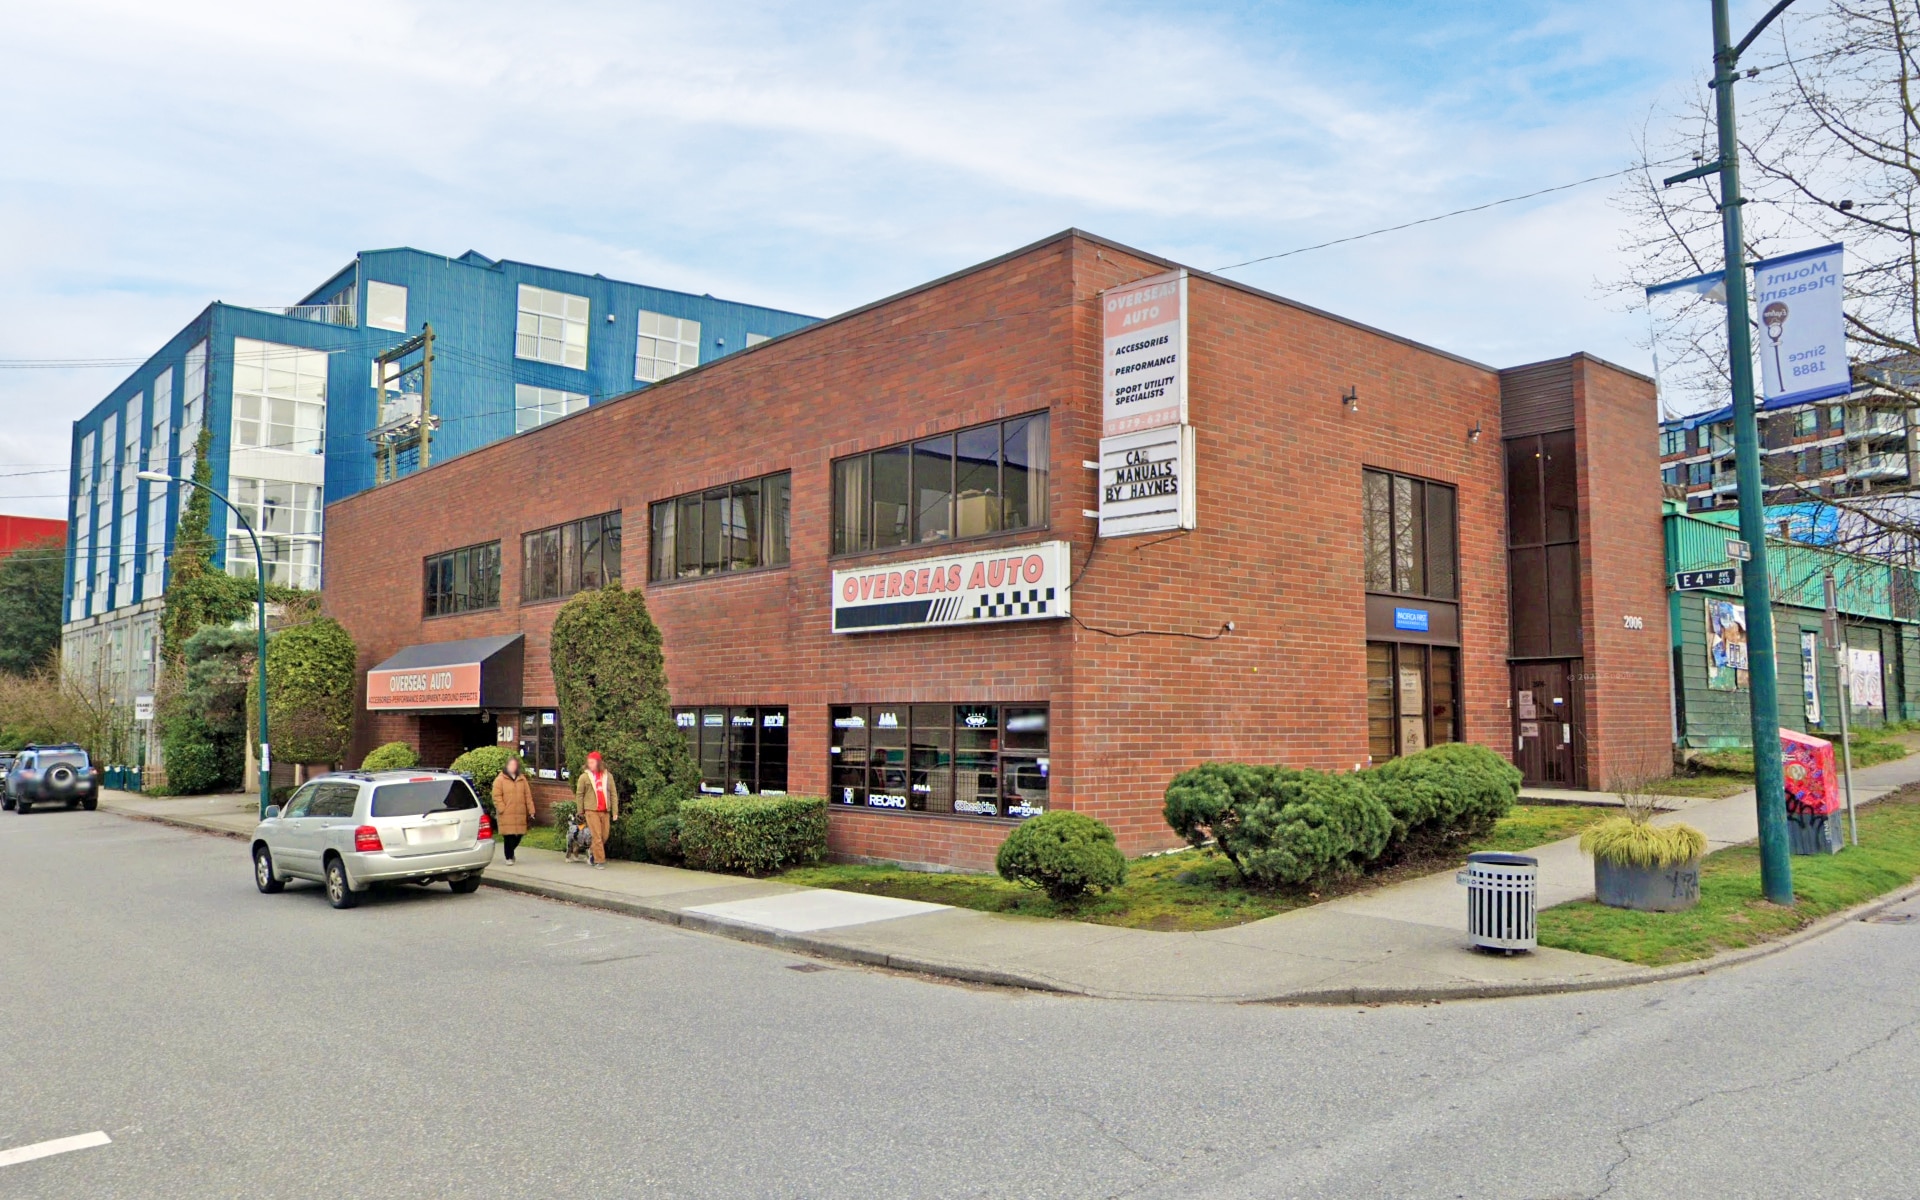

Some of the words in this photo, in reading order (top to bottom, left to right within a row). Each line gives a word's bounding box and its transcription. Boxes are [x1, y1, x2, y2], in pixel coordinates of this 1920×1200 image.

[1107, 280, 1177, 313] OVERSEAS
[1122, 305, 1160, 327] AUTO
[1115, 335, 1169, 356] ACCESSORIES
[1115, 354, 1176, 376] PERFORMANCE
[1115, 383, 1142, 397] SPORT
[1144, 375, 1175, 390] UTILITY
[1115, 387, 1165, 406] SPECIALISTS
[1116, 461, 1172, 484] MANUALS
[1105, 486, 1122, 502] BY
[1130, 477, 1178, 499] HAYNES
[842, 564, 962, 602] OVERSEAS
[967, 554, 1044, 590] AUTO
[1683, 574, 1691, 587] E
[1623, 615, 1643, 630] 2006
[390, 674, 427, 693] OVERSEAS
[430, 671, 452, 691] AUTO
[497, 726, 514, 742] 210
[869, 794, 907, 808] RECARO
[1008, 805, 1044, 817] personal
